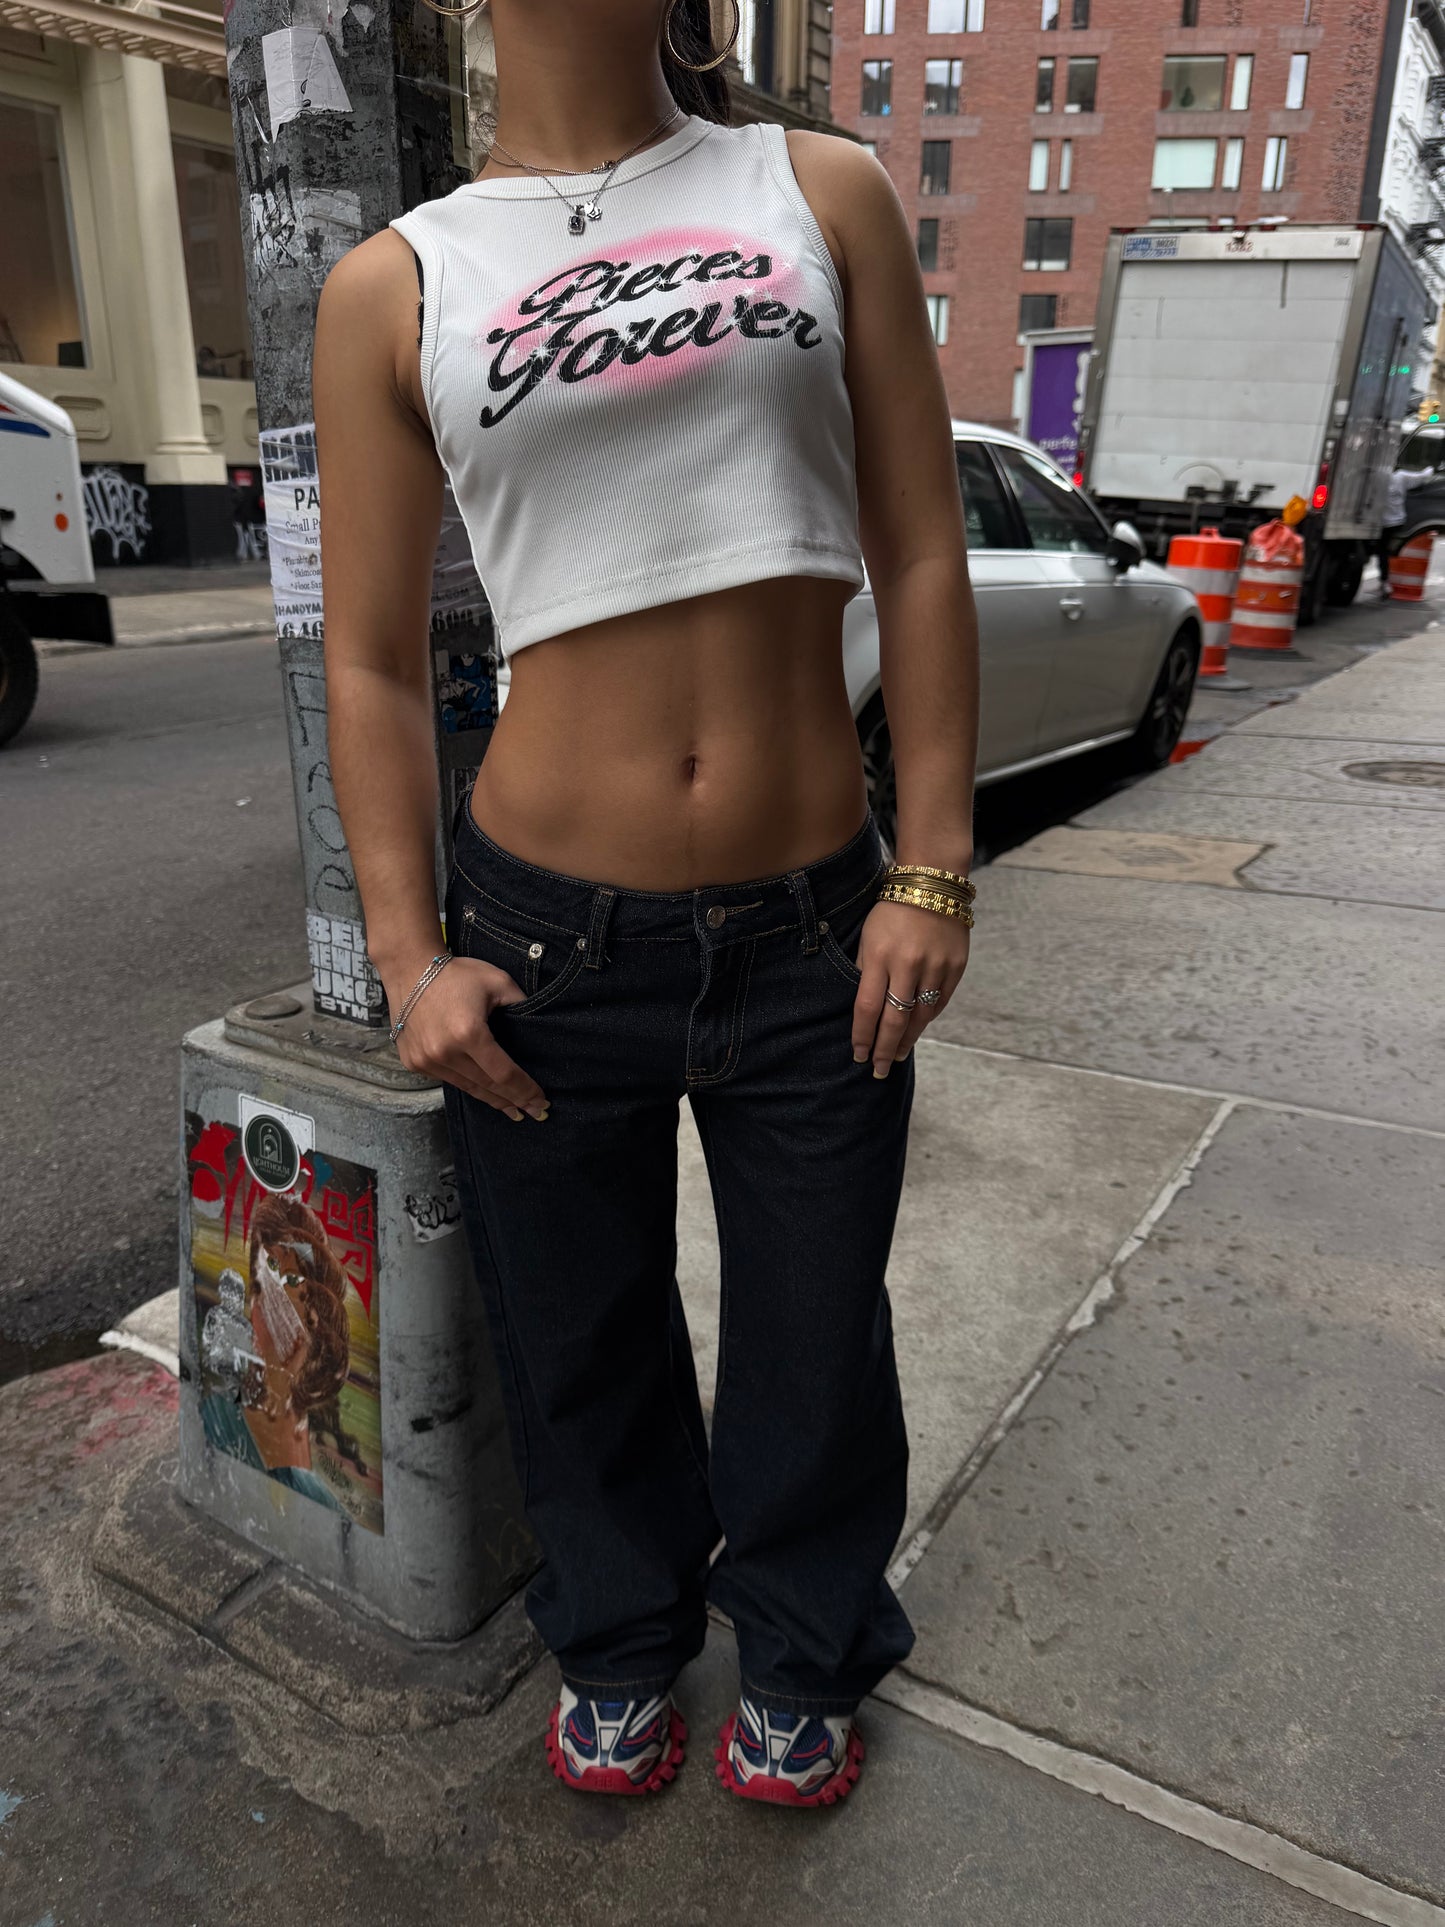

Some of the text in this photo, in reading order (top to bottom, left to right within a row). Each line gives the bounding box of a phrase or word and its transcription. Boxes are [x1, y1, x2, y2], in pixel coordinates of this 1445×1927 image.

[518, 250, 773, 318] Pieces
[479, 294, 822, 428] Forever
[294, 485, 320, 511] PA
[285, 518, 309, 534] Small
[320, 995, 369, 1021] BTM
